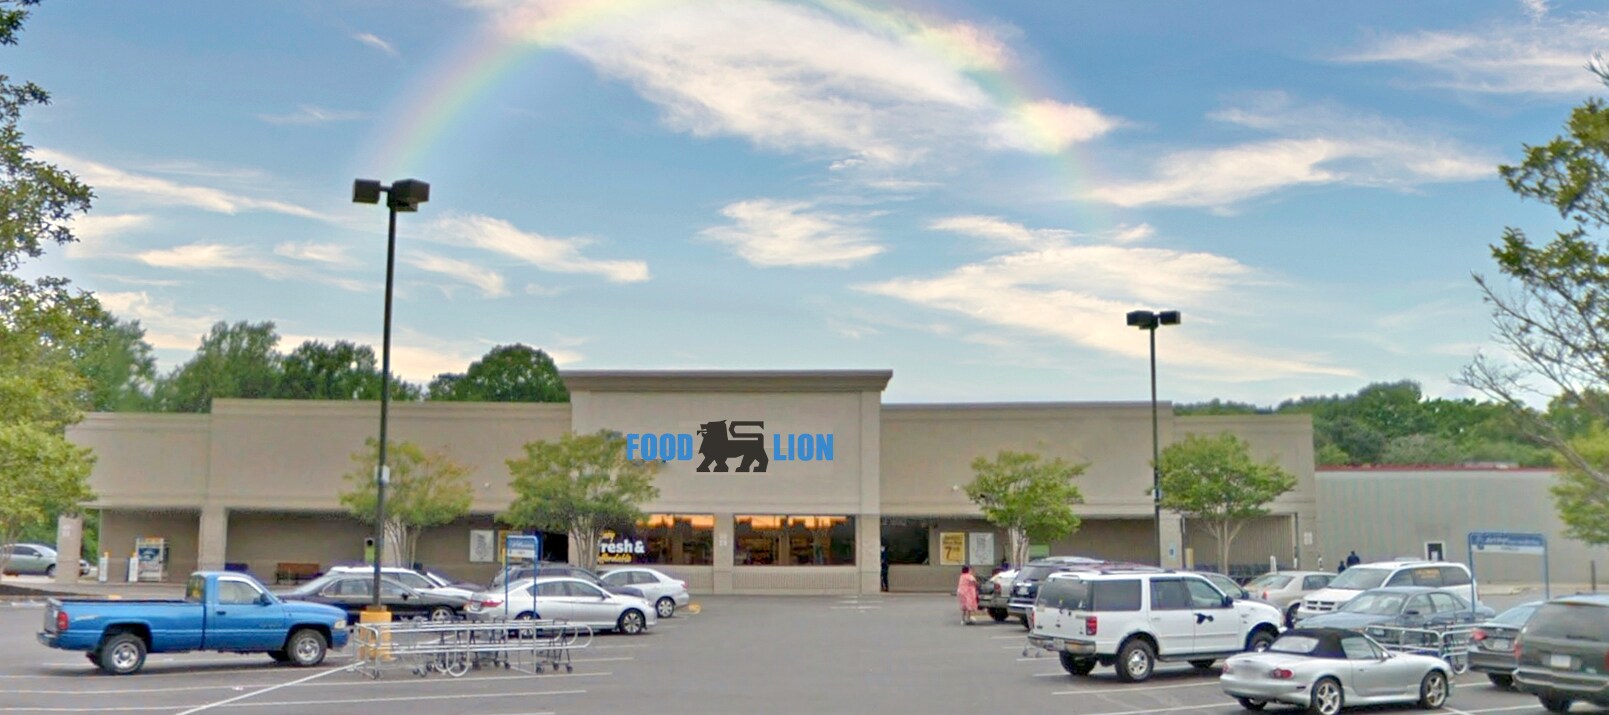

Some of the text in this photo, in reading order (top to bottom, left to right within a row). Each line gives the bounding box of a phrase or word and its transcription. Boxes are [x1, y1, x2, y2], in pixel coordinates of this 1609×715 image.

[626, 433, 834, 461] FOOD LION
[599, 539, 633, 553] resh
